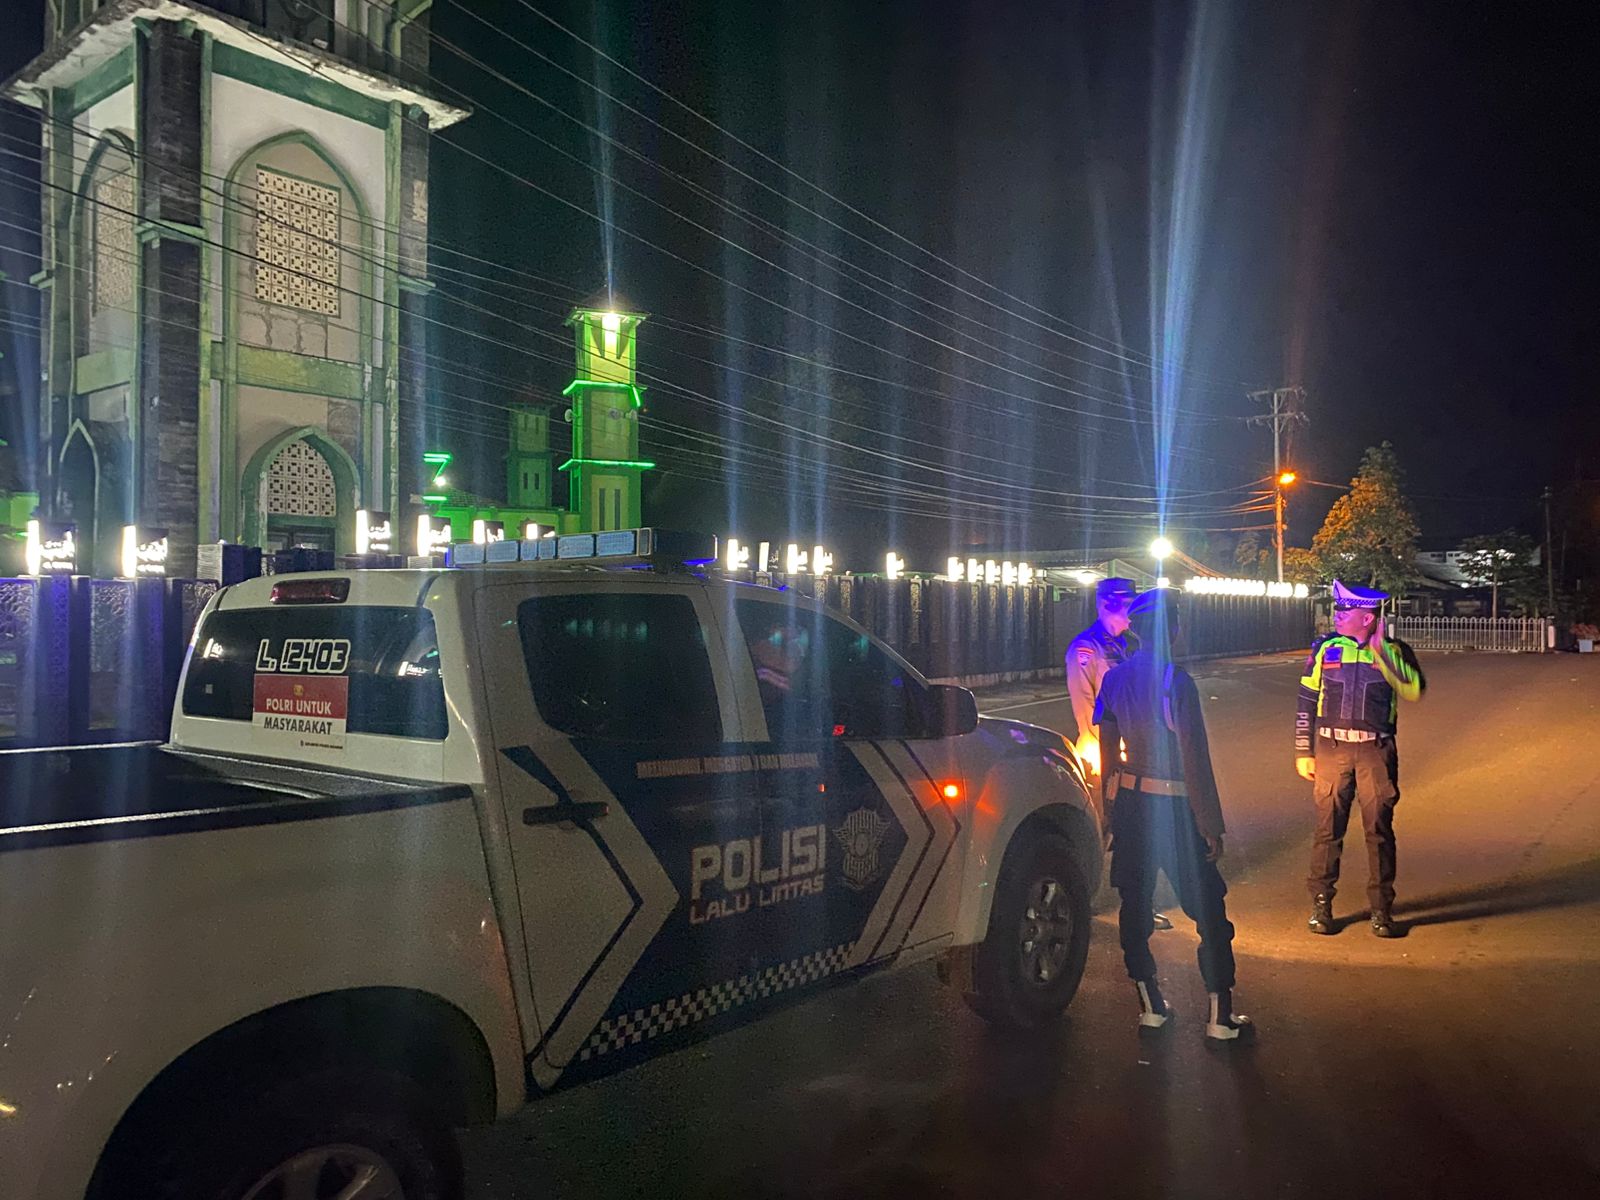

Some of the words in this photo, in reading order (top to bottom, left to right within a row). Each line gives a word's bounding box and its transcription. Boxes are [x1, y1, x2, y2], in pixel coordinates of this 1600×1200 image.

[263, 716, 333, 735] MASYARAKAT
[266, 698, 293, 712] POLRI
[296, 700, 332, 715] UNTUK
[1295, 712, 1310, 750] POLISI
[691, 824, 826, 900] POLISI
[689, 893, 749, 925] LALU
[759, 874, 825, 907] LINTAS
